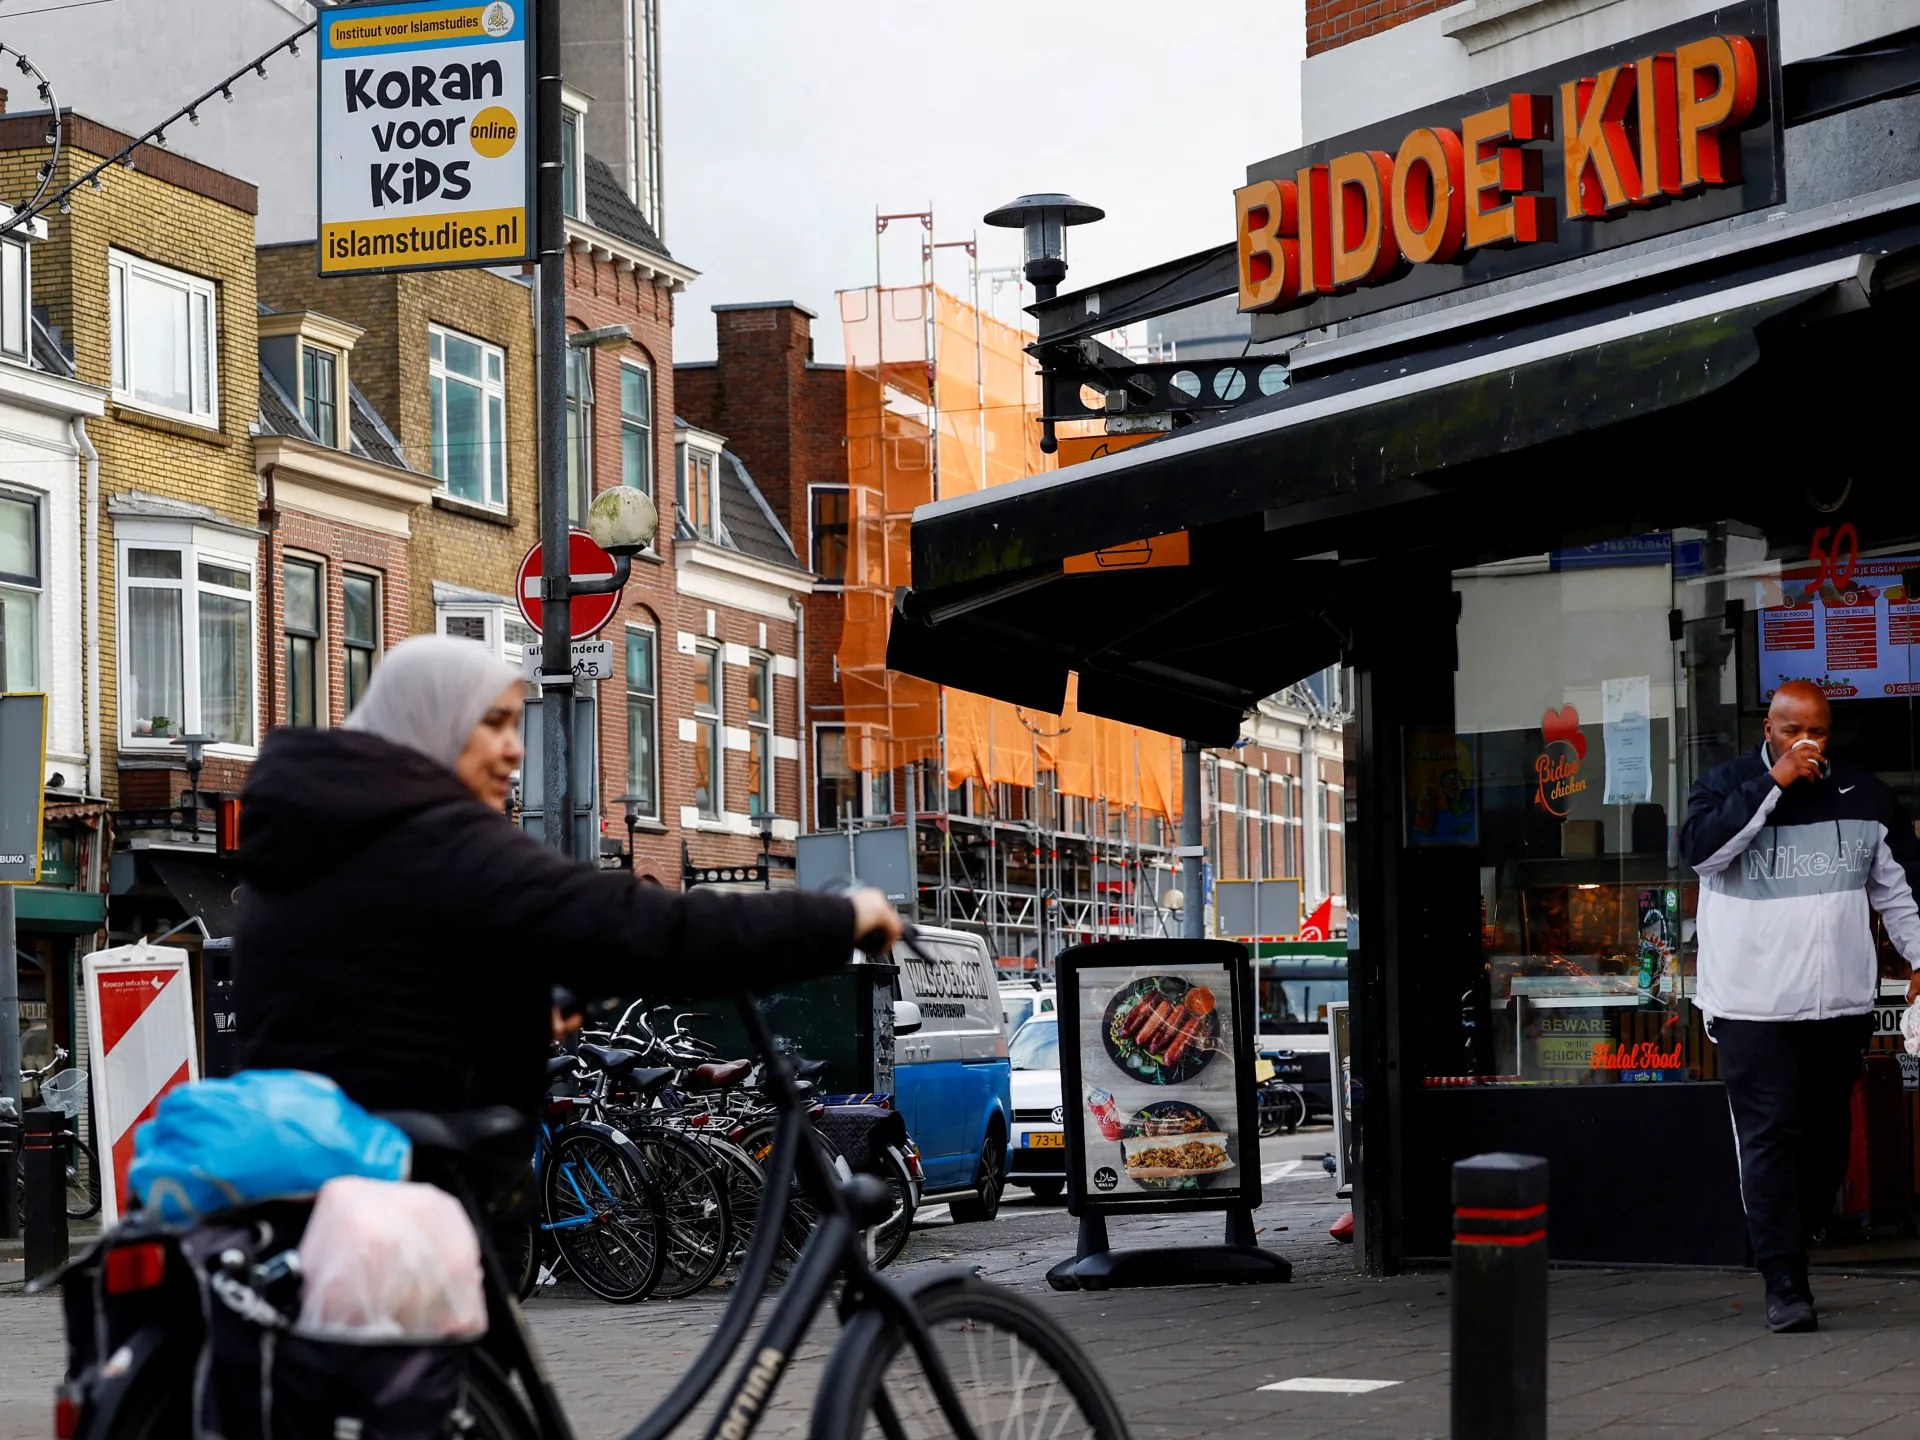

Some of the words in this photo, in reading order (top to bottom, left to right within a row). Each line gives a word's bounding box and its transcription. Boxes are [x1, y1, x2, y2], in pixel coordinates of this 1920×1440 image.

[336, 25, 382, 41] Instituut
[384, 24, 408, 36] voor
[410, 16, 479, 33] Islamstudies
[371, 116, 466, 152] voor
[471, 122, 516, 140] online
[1234, 92, 1557, 314] BIDOE
[1559, 34, 1758, 222] KIP
[329, 216, 518, 259] islamstudies.nl
[1870, 565, 1895, 578] EIGEN
[1550, 776, 1587, 800] chicken
[125, 979, 141, 987] Infra
[1541, 1019, 1612, 1032] BEWARE
[1542, 1050, 1604, 1062] CHICKE
[1590, 1043, 1640, 1070] Halal
[1640, 1042, 1682, 1069] Food
[1901, 1063, 1919, 1072] WAY
[1035, 1134, 1064, 1146] 73-L
